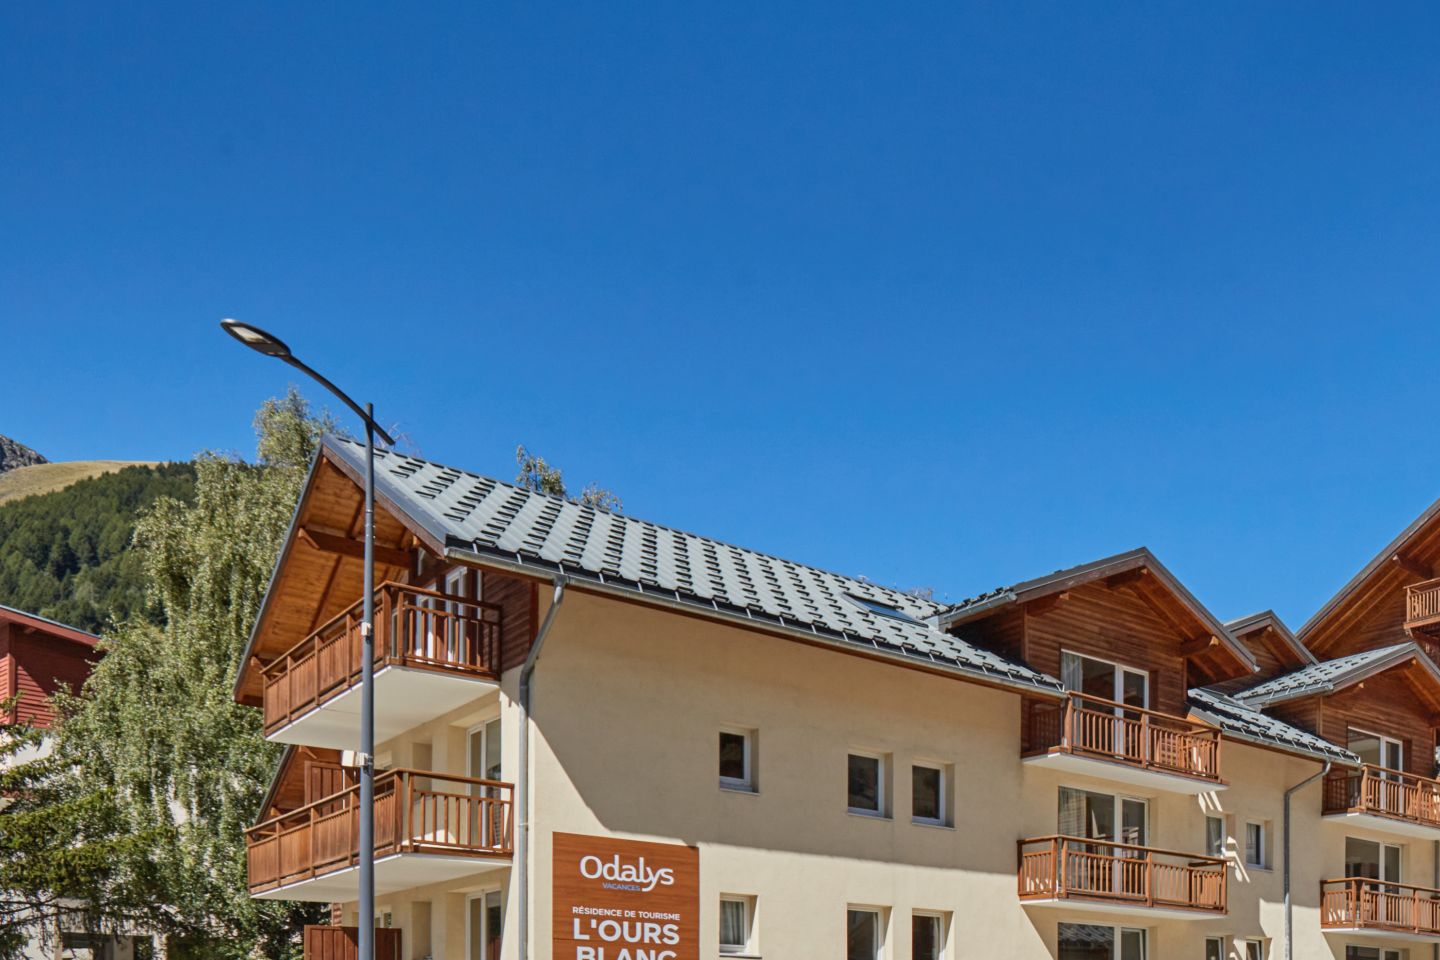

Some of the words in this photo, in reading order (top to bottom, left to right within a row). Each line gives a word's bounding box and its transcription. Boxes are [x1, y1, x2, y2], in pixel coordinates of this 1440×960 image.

[580, 854, 675, 892] Odalys
[602, 882, 641, 891] VACANCES
[572, 906, 622, 917] RÉSIDENCE
[624, 910, 636, 918] DE
[638, 911, 680, 920] TOURISME
[573, 918, 680, 945] L'OURS
